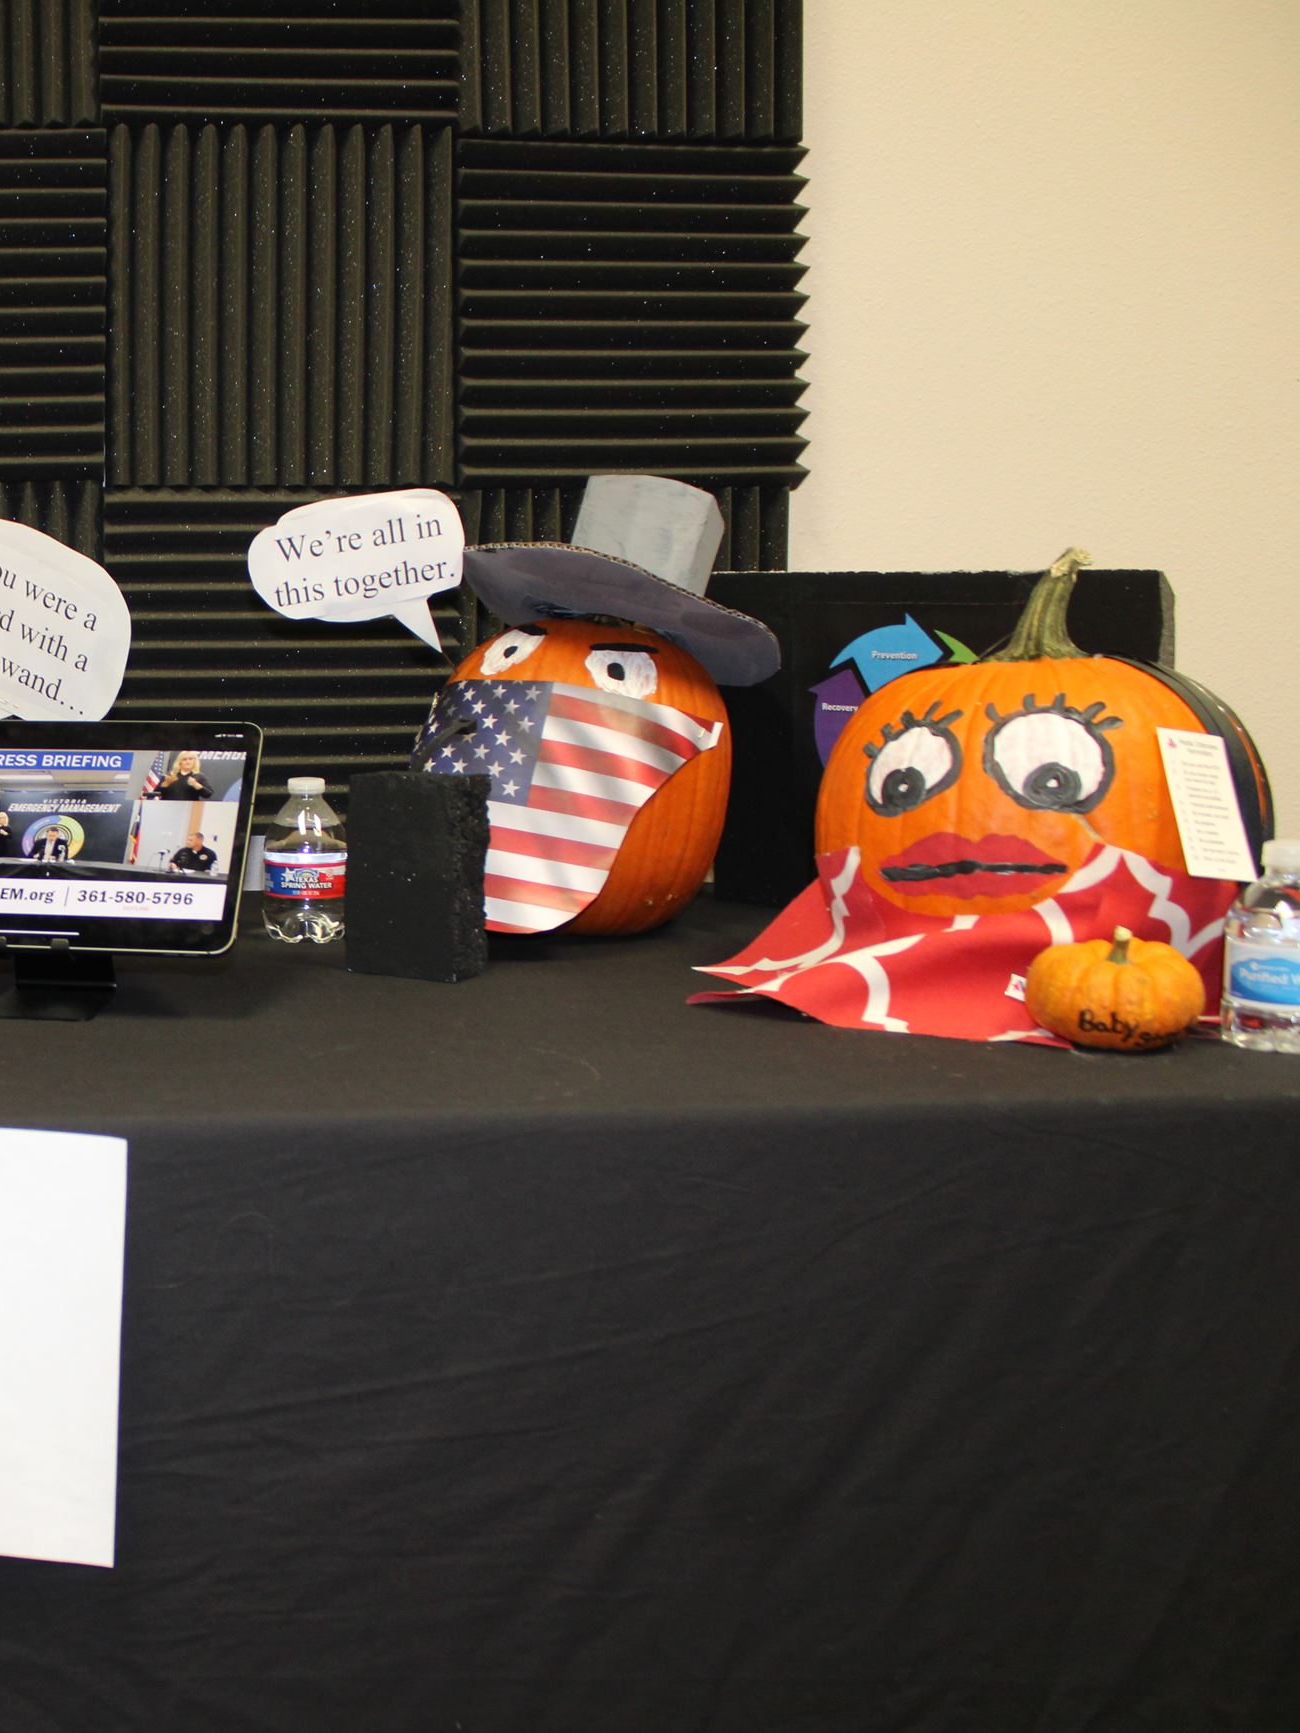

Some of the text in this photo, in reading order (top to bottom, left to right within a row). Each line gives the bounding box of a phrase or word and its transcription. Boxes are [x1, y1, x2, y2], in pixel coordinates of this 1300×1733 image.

[275, 514, 443, 562] We're all in
[274, 560, 455, 607] this together.
[25, 580, 78, 621] were
[83, 612, 98, 631] a
[20, 622, 69, 663] with
[74, 653, 89, 672] a
[871, 650, 918, 660] Prevention
[1, 656, 84, 715] wand...
[821, 702, 859, 712] Recovery
[42, 755, 123, 768] BRIEFING
[8, 803, 121, 813] EMERGENCY MANAGEMENT
[281, 881, 307, 889] SPRING
[77, 890, 194, 906] 361-580-5796
[1078, 1008, 1139, 1042] Baby
